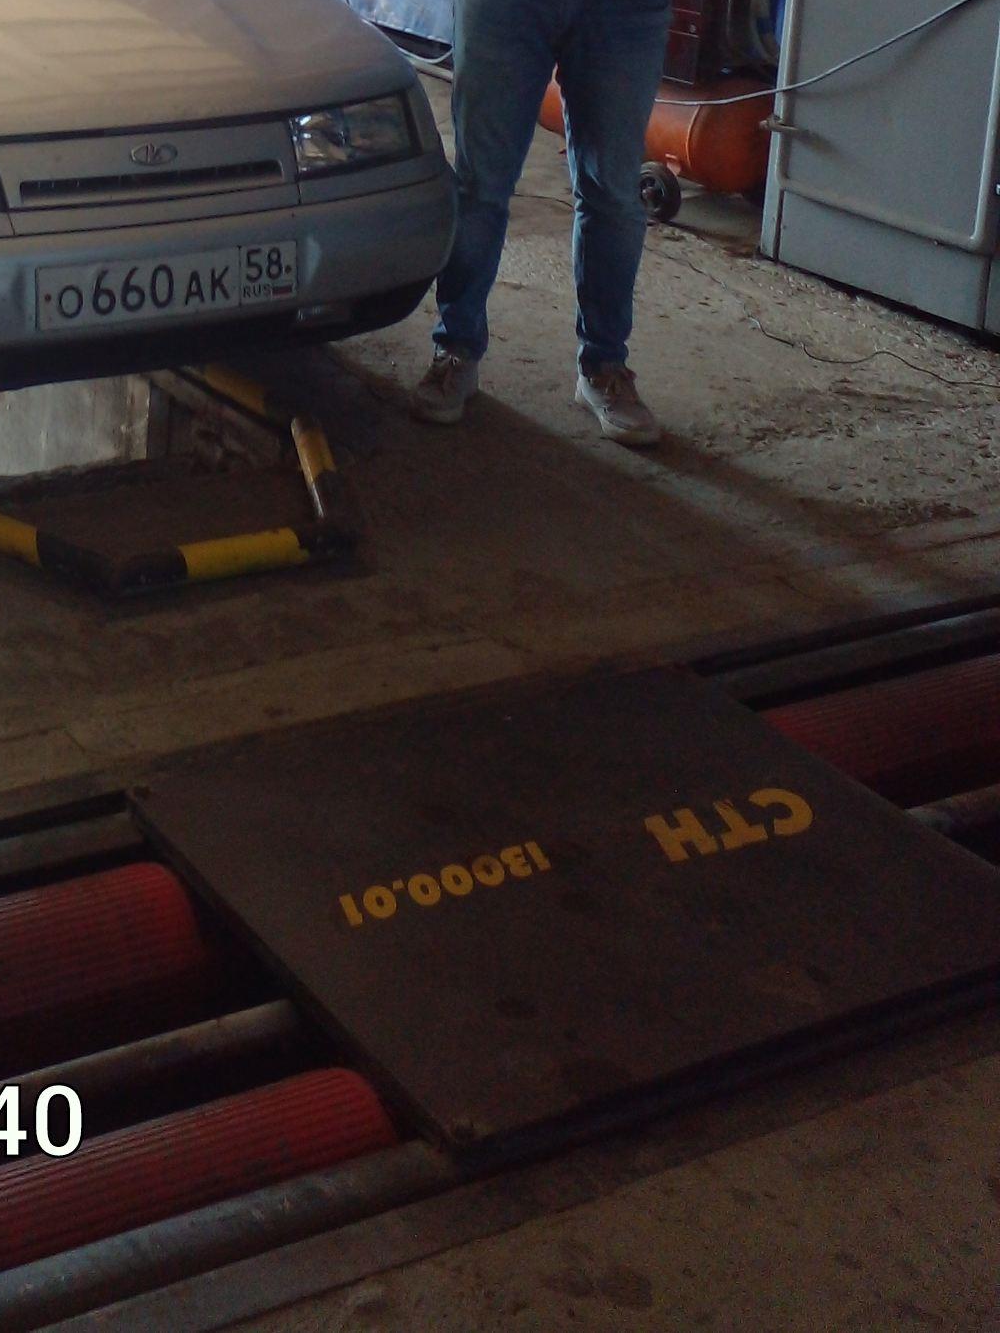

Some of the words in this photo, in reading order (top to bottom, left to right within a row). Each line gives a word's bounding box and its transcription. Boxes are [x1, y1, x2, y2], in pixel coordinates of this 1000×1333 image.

[246, 247, 284, 283] 58
[243, 282, 273, 299] RUS
[338, 841, 552, 928] 13000.01
